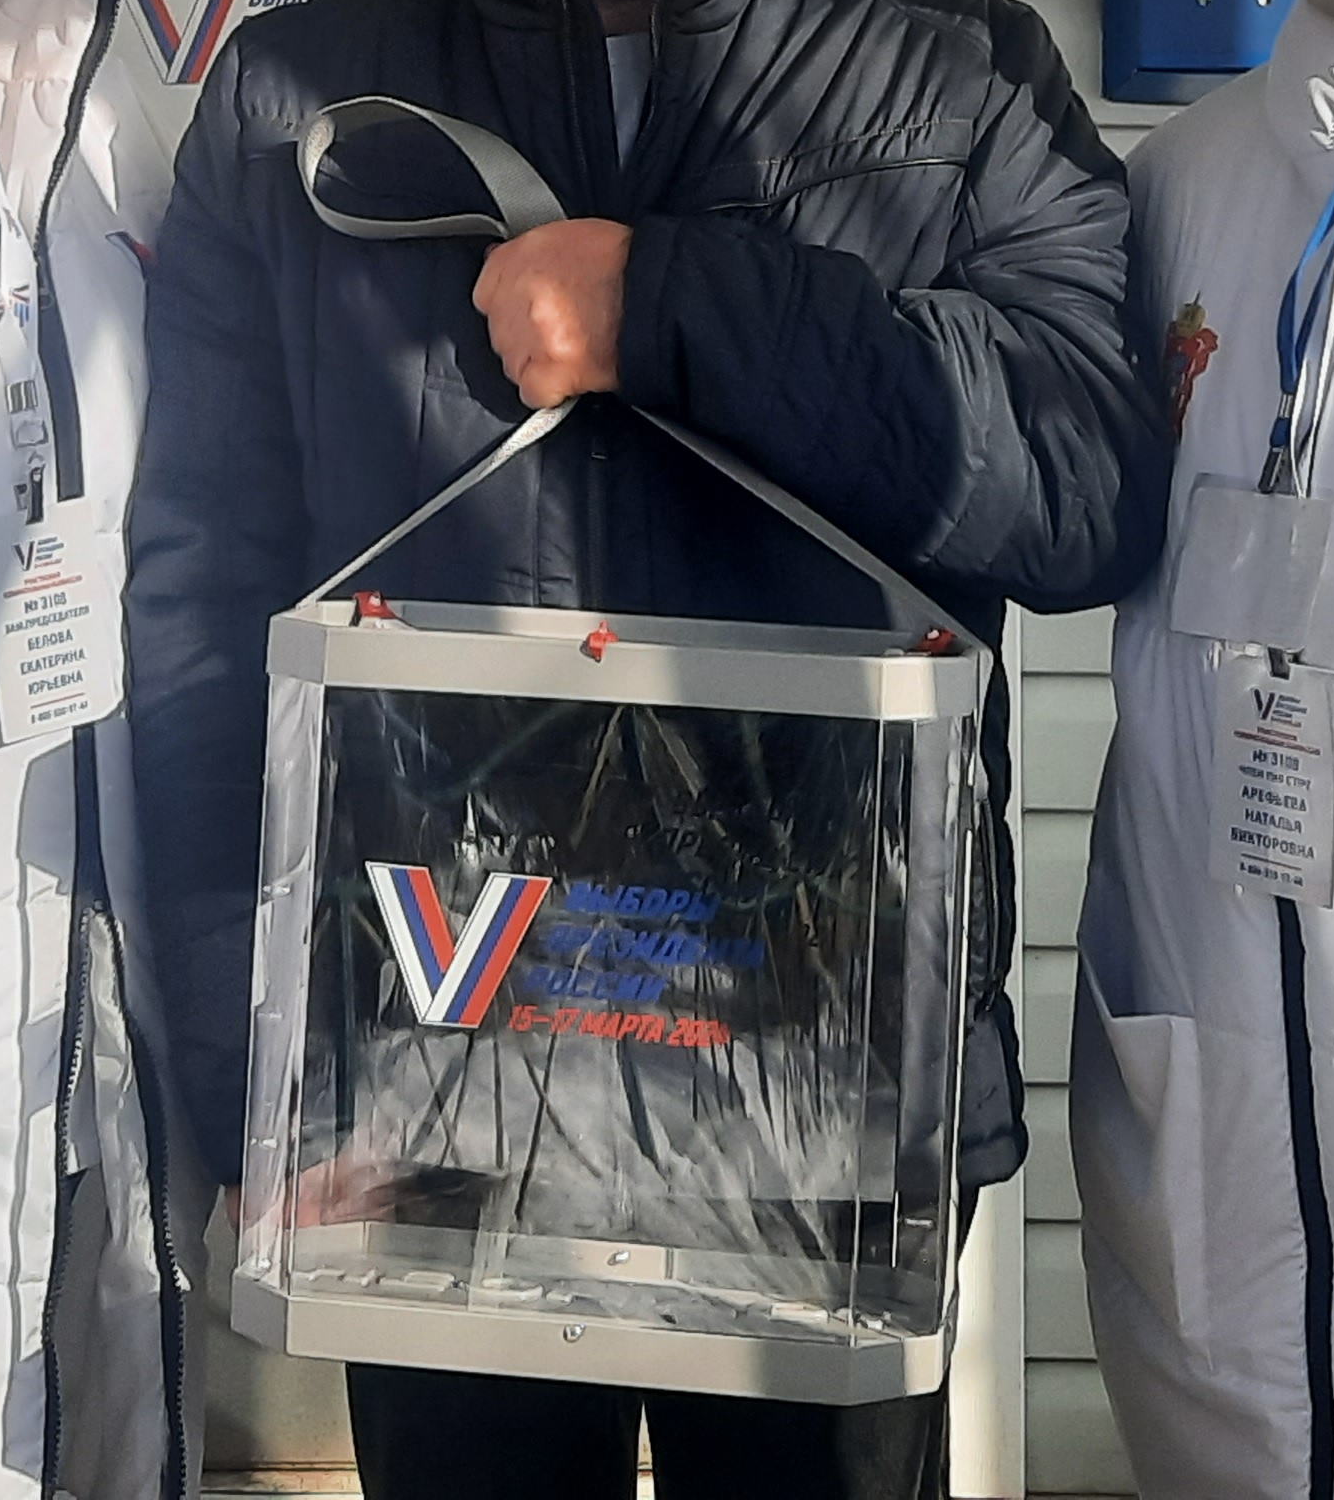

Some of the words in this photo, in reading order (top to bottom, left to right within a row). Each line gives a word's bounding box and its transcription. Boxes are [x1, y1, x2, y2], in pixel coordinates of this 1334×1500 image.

[27, 629, 74, 651] БЕЛОВА
[20, 649, 88, 676] ЕКАТЕРИНА
[28, 670, 83, 695] ЮРЬЕВНА
[1244, 808, 1302, 834] НАТАЛЬЯ
[1230, 827, 1315, 860] ВИКТОРОВНА
[567, 881, 720, 922] ВЫБОРЫ
[522, 964, 670, 1003] РОССИИ
[579, 1010, 664, 1043] МАРТА
